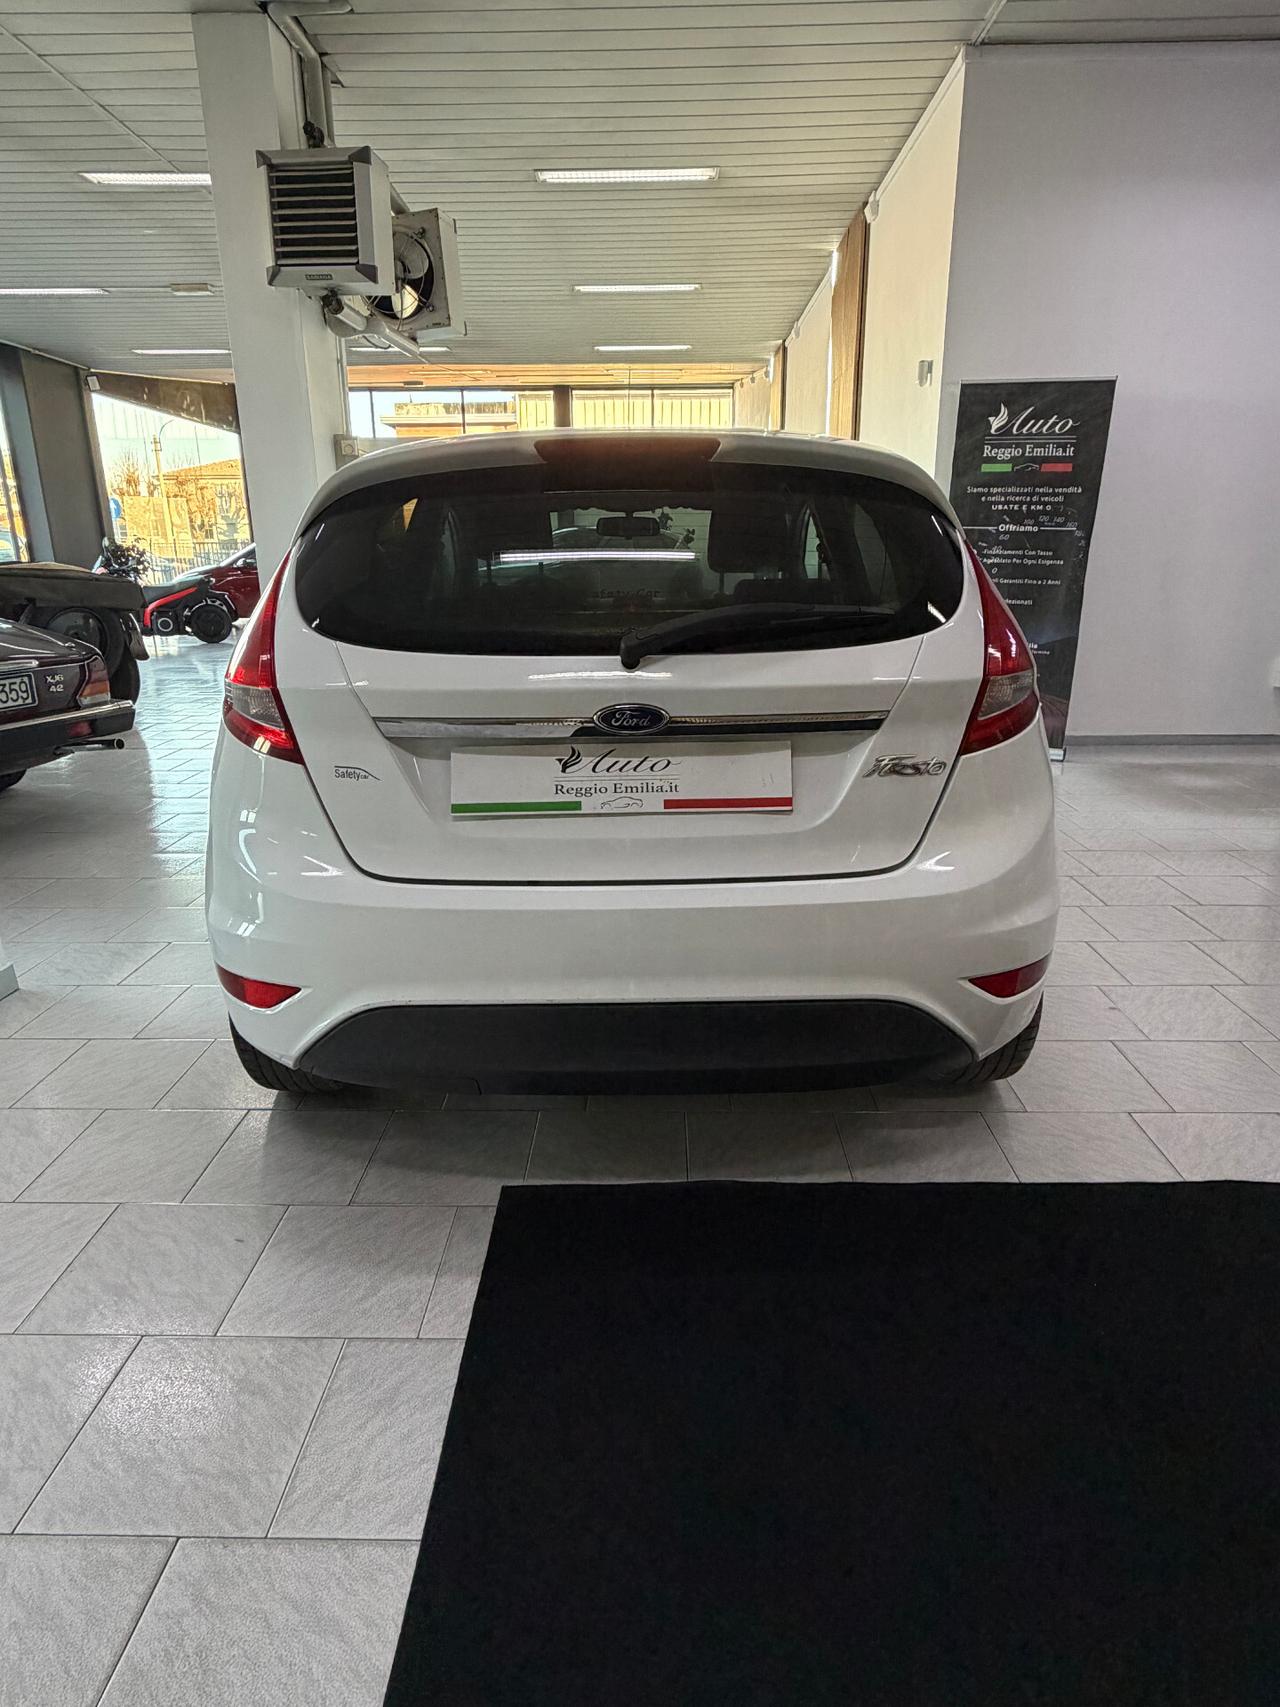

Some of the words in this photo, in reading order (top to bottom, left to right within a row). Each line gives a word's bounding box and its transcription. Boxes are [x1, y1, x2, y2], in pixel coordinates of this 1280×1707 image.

[988, 402, 1080, 435] Auto
[983, 445, 1022, 460] Reggio
[1025, 444, 1075, 457] Emilia.it
[967, 486, 988, 494] Siamo
[990, 486, 1033, 495] specializzati
[999, 523, 1038, 532] Offriamo
[46, 674, 64, 683] XJ6
[611, 710, 650, 726] Ford
[555, 745, 681, 774] Auto
[862, 753, 946, 777] Fiesta
[334, 768, 361, 781] Safety
[554, 783, 608, 797] Reggio
[612, 781, 680, 795] Emilia.it
